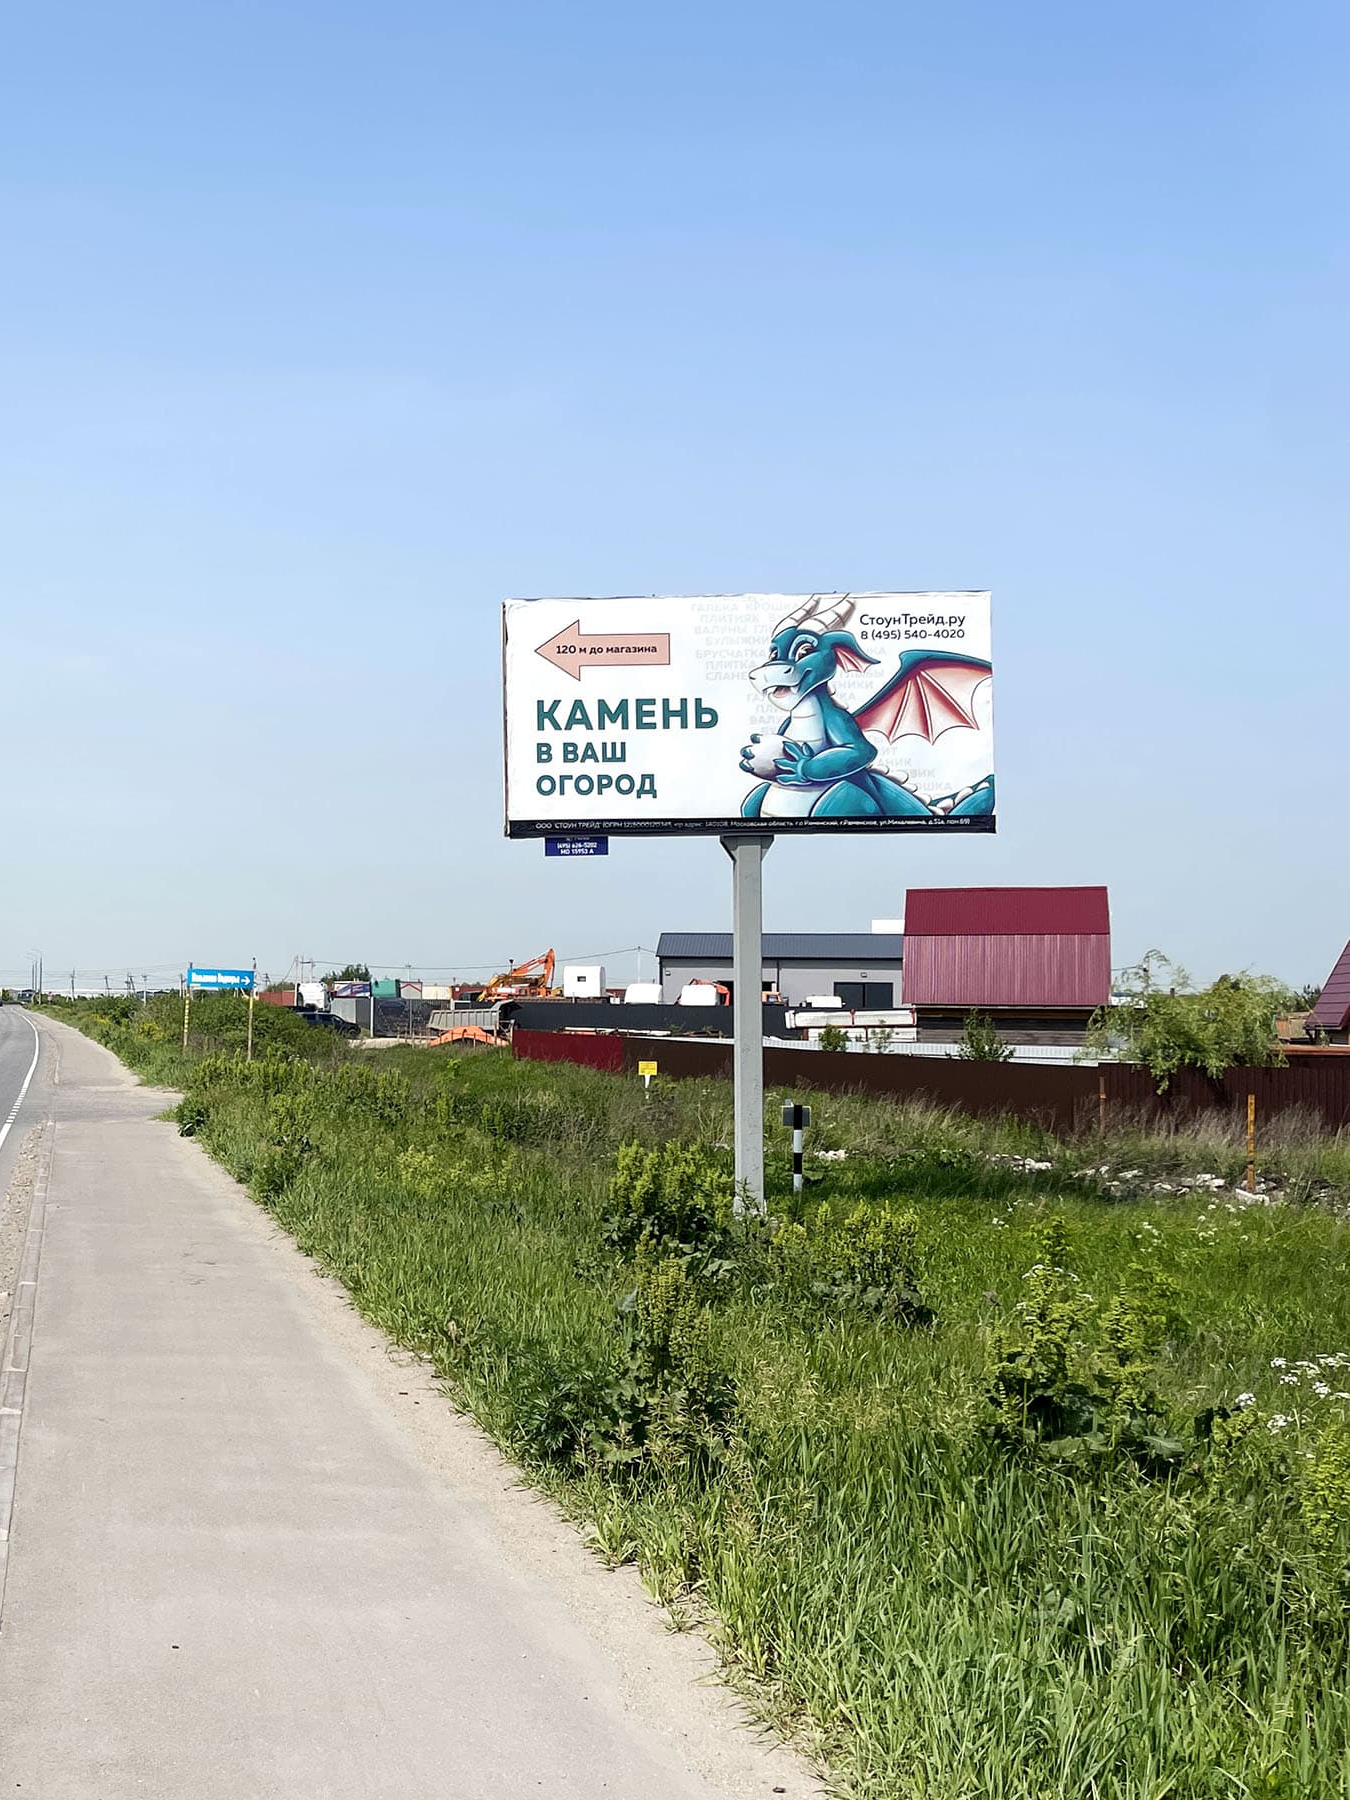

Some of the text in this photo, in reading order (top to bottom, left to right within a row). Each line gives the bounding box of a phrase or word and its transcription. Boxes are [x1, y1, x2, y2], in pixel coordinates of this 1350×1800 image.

[859, 613, 966, 628] СтоунТрейд.ру
[860, 629, 965, 641] 8 (495) 540-4020
[556, 645, 658, 656] 120 м до магазина
[537, 698, 719, 731] КАМЕНЬ
[537, 742, 626, 763] В ВАШ
[536, 774, 658, 799] ОГОРОД
